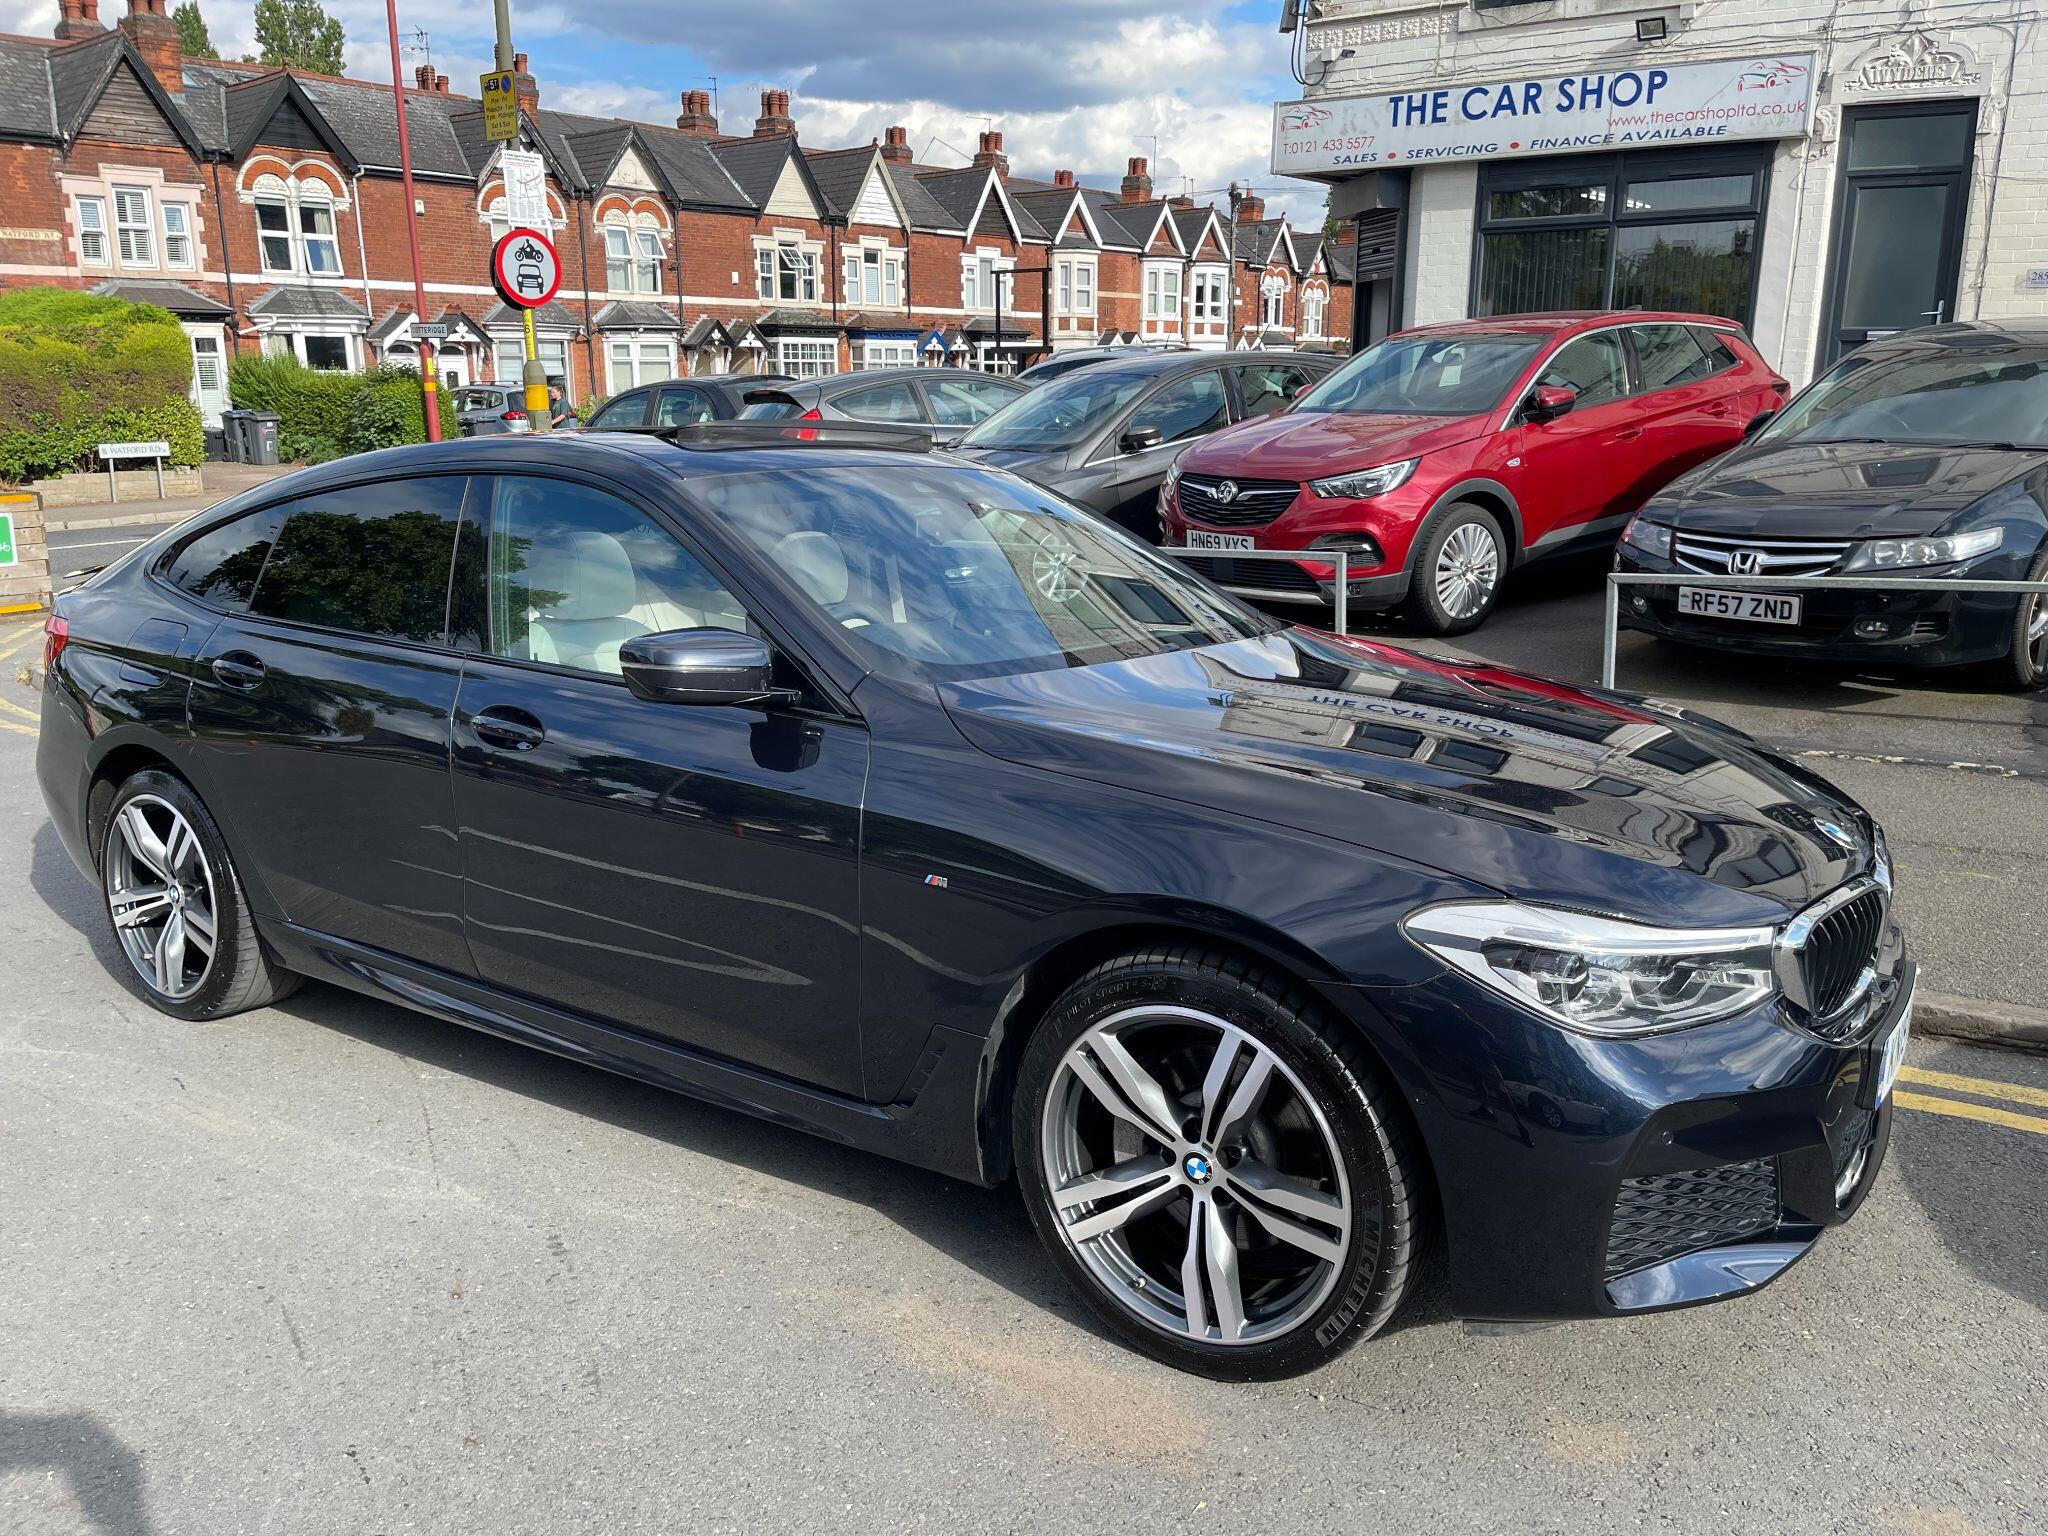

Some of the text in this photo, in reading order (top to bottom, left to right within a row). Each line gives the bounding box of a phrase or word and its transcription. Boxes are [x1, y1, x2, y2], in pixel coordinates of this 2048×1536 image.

[1389, 70, 1668, 128] THE CAR SHOP
[1606, 100, 1807, 128] www.thecarshopltd.co.uk
[1283, 135, 1376, 155] T:0121 433 5577
[1333, 125, 1728, 165] SALES SERVICING FINANCE AVAILABLE
[110, 446, 147, 454] WATFORD
[1191, 532, 1220, 549] HN69
[1691, 591, 1792, 620] RF57 ZND
[1321, 1217, 1381, 1342] MICHELIN
